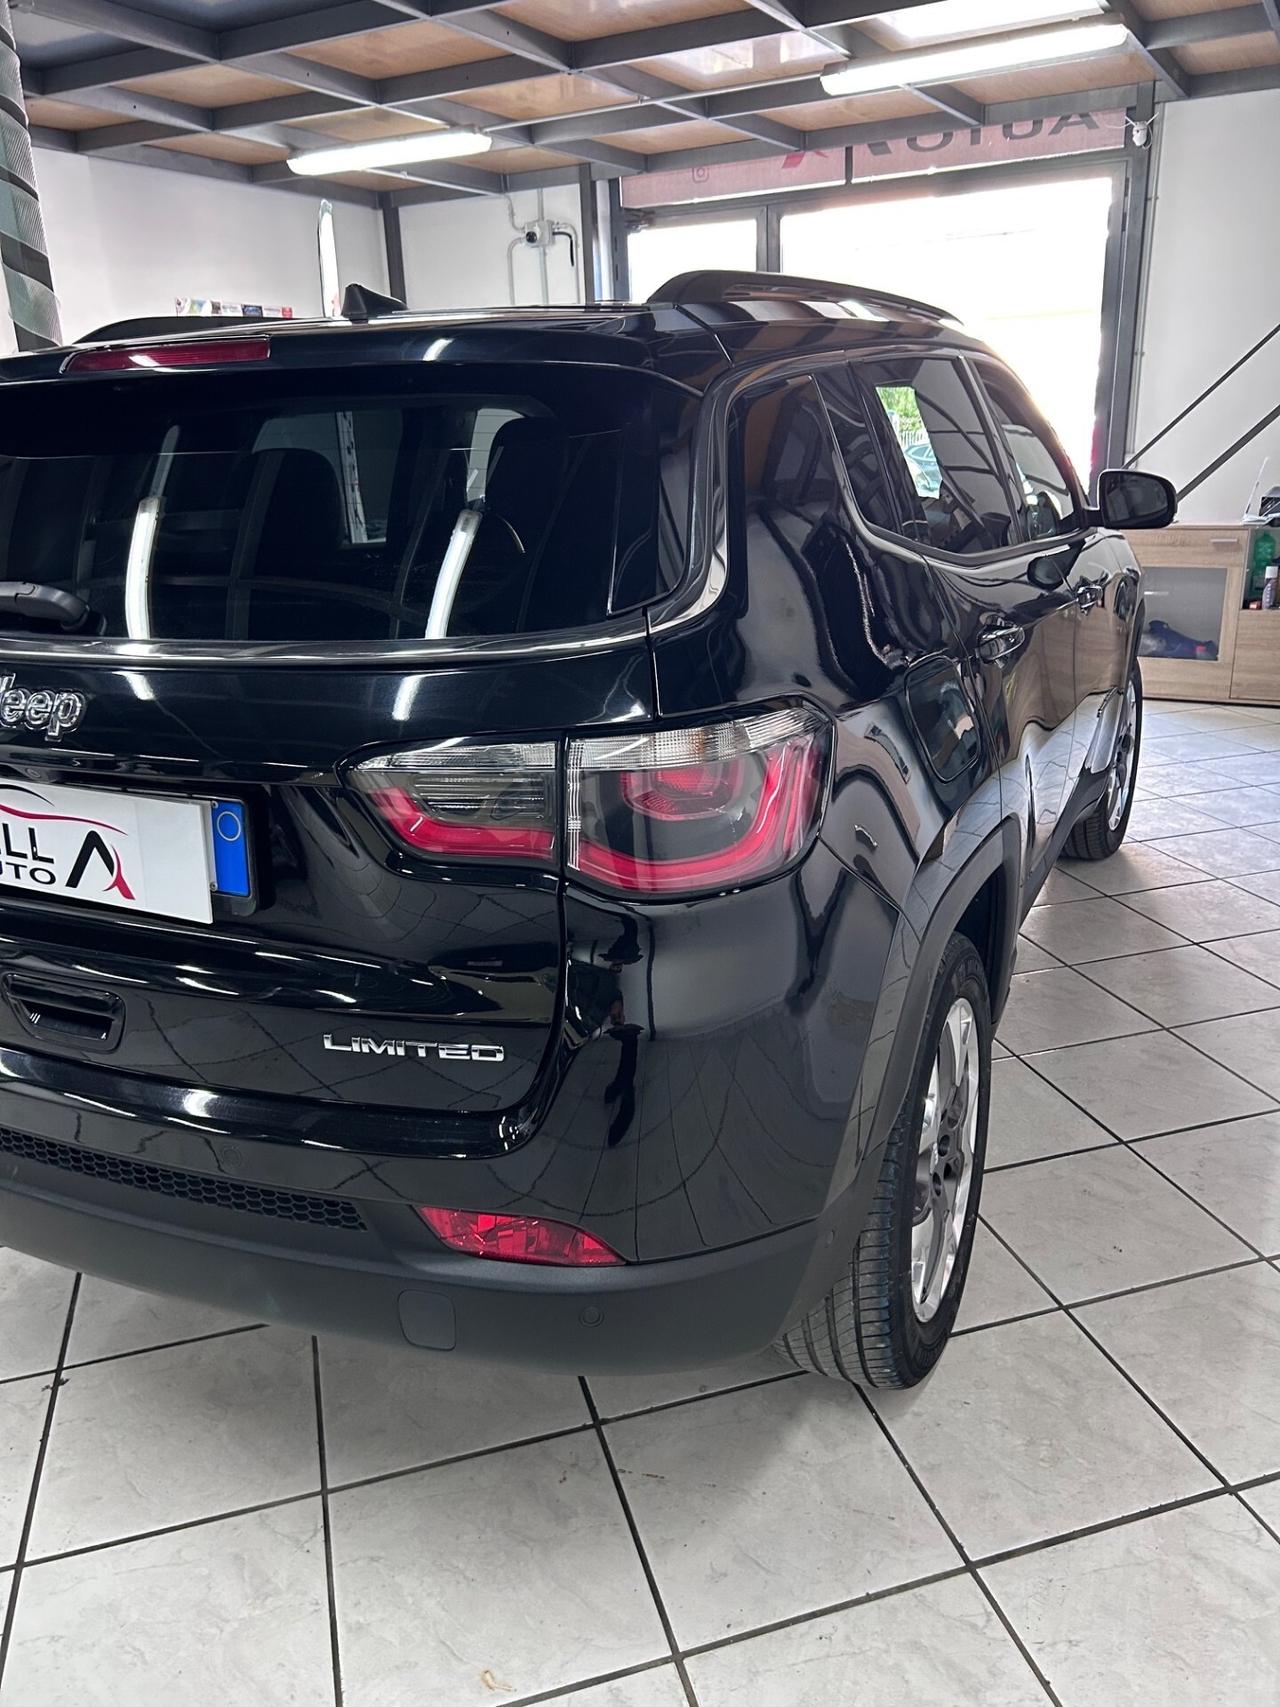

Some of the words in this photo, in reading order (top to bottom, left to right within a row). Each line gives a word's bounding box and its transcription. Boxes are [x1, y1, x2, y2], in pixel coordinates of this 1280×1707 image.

[0, 823, 54, 864] LL
[0, 861, 56, 885] TO
[323, 1033, 505, 1062] LIMITED
